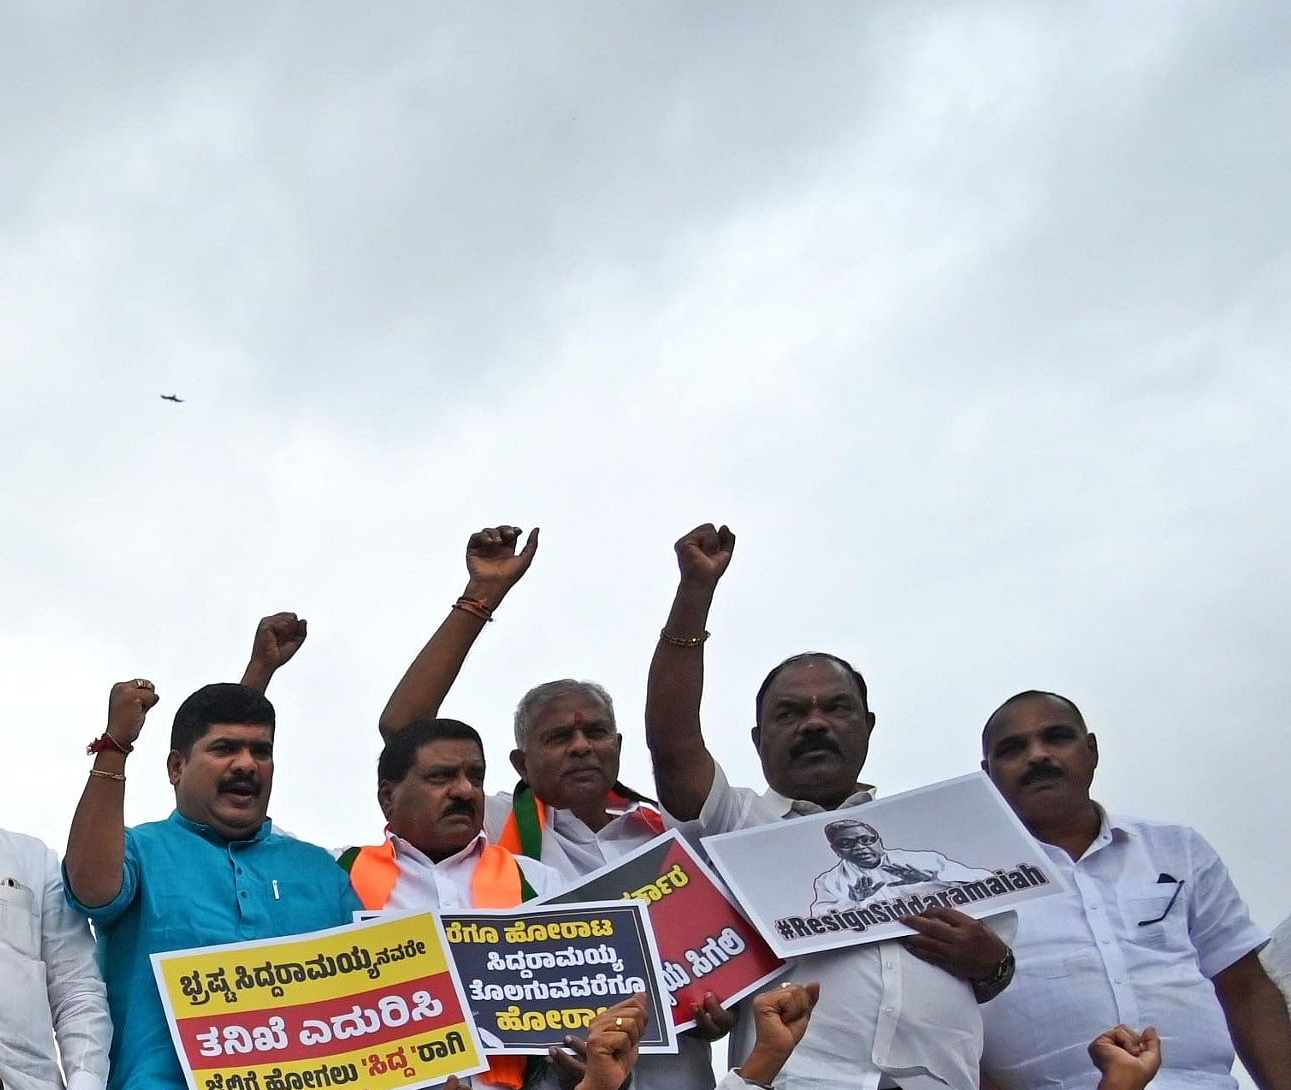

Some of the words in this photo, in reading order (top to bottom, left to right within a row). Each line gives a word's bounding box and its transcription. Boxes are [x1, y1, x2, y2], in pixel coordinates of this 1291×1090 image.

[775, 862, 1050, 940] #ResignSiddaramaiah
[505, 918, 613, 943] ಹೋರಾಟ
[487, 944, 623, 979] ಸಿದ್ದರಾಮಯ್ಯ
[685, 927, 746, 977] ಸಿಗಲಿ
[180, 970, 237, 1005] ಭ್ರಷ್ಟ
[470, 974, 646, 1002] ತೊಲಗುವವರೆಗೂ
[196, 1016, 288, 1057] ತನಿಖೆ
[299, 990, 443, 1044] ಎದುರಿಸಿ
